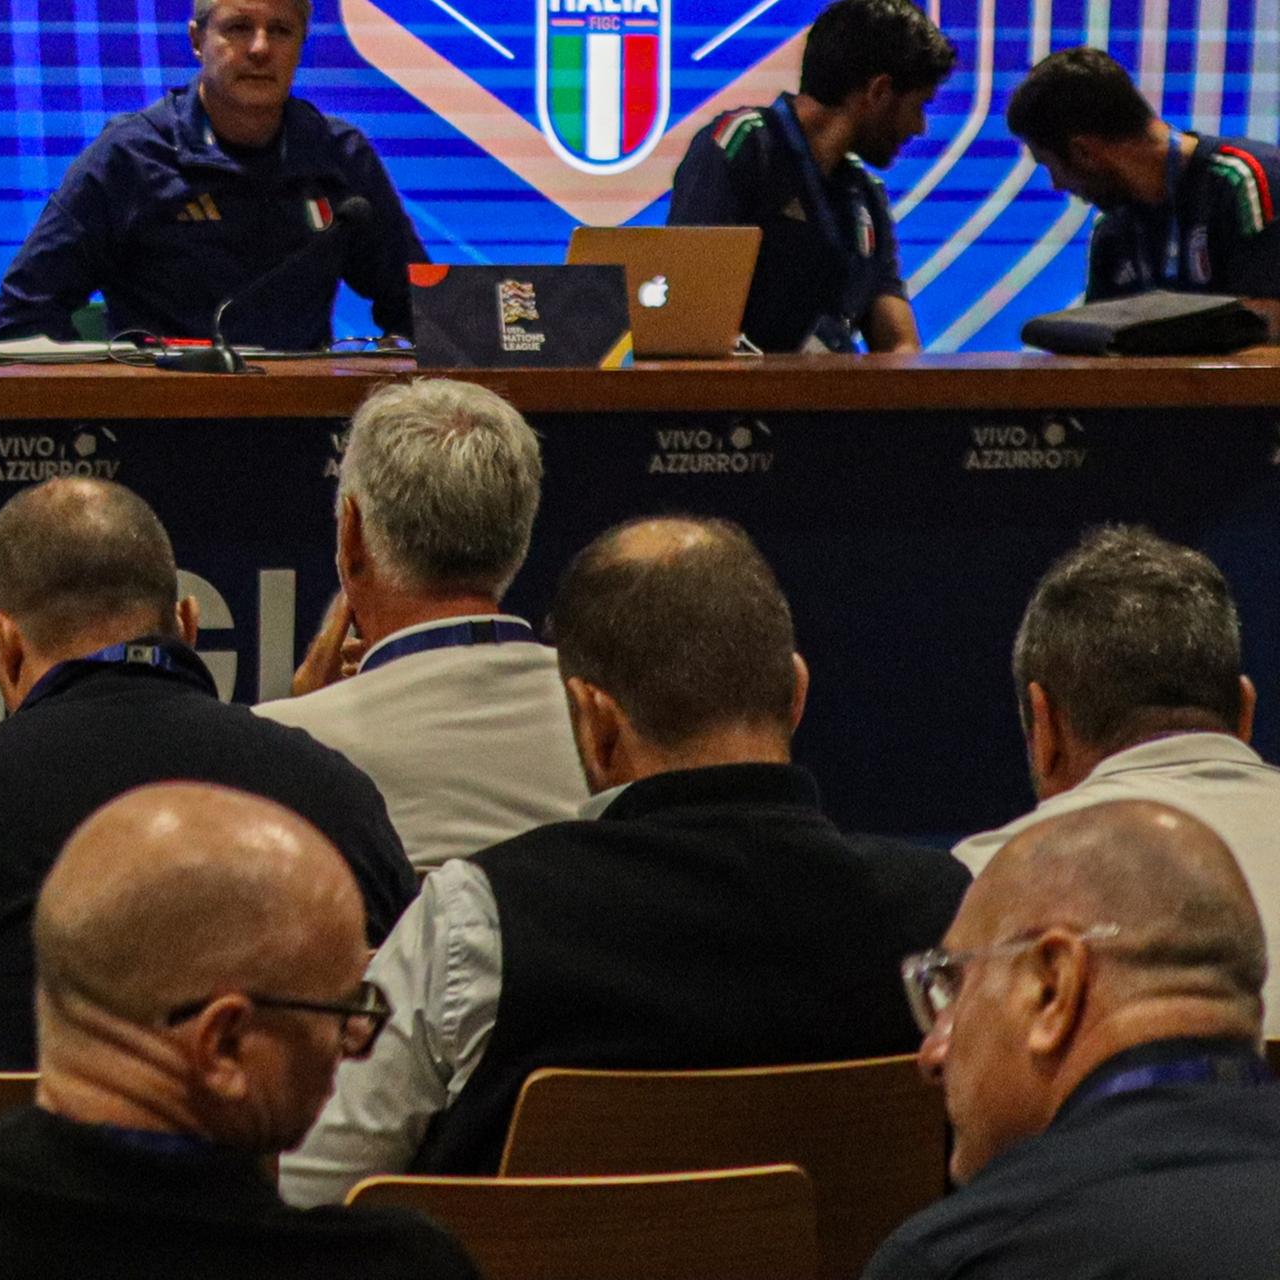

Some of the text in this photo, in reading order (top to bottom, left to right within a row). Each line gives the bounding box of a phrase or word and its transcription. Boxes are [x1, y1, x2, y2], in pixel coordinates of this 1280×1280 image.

[588, 15, 622, 32] FIGC
[657, 429, 713, 450] VIVO
[973, 426, 1028, 447] VIVO
